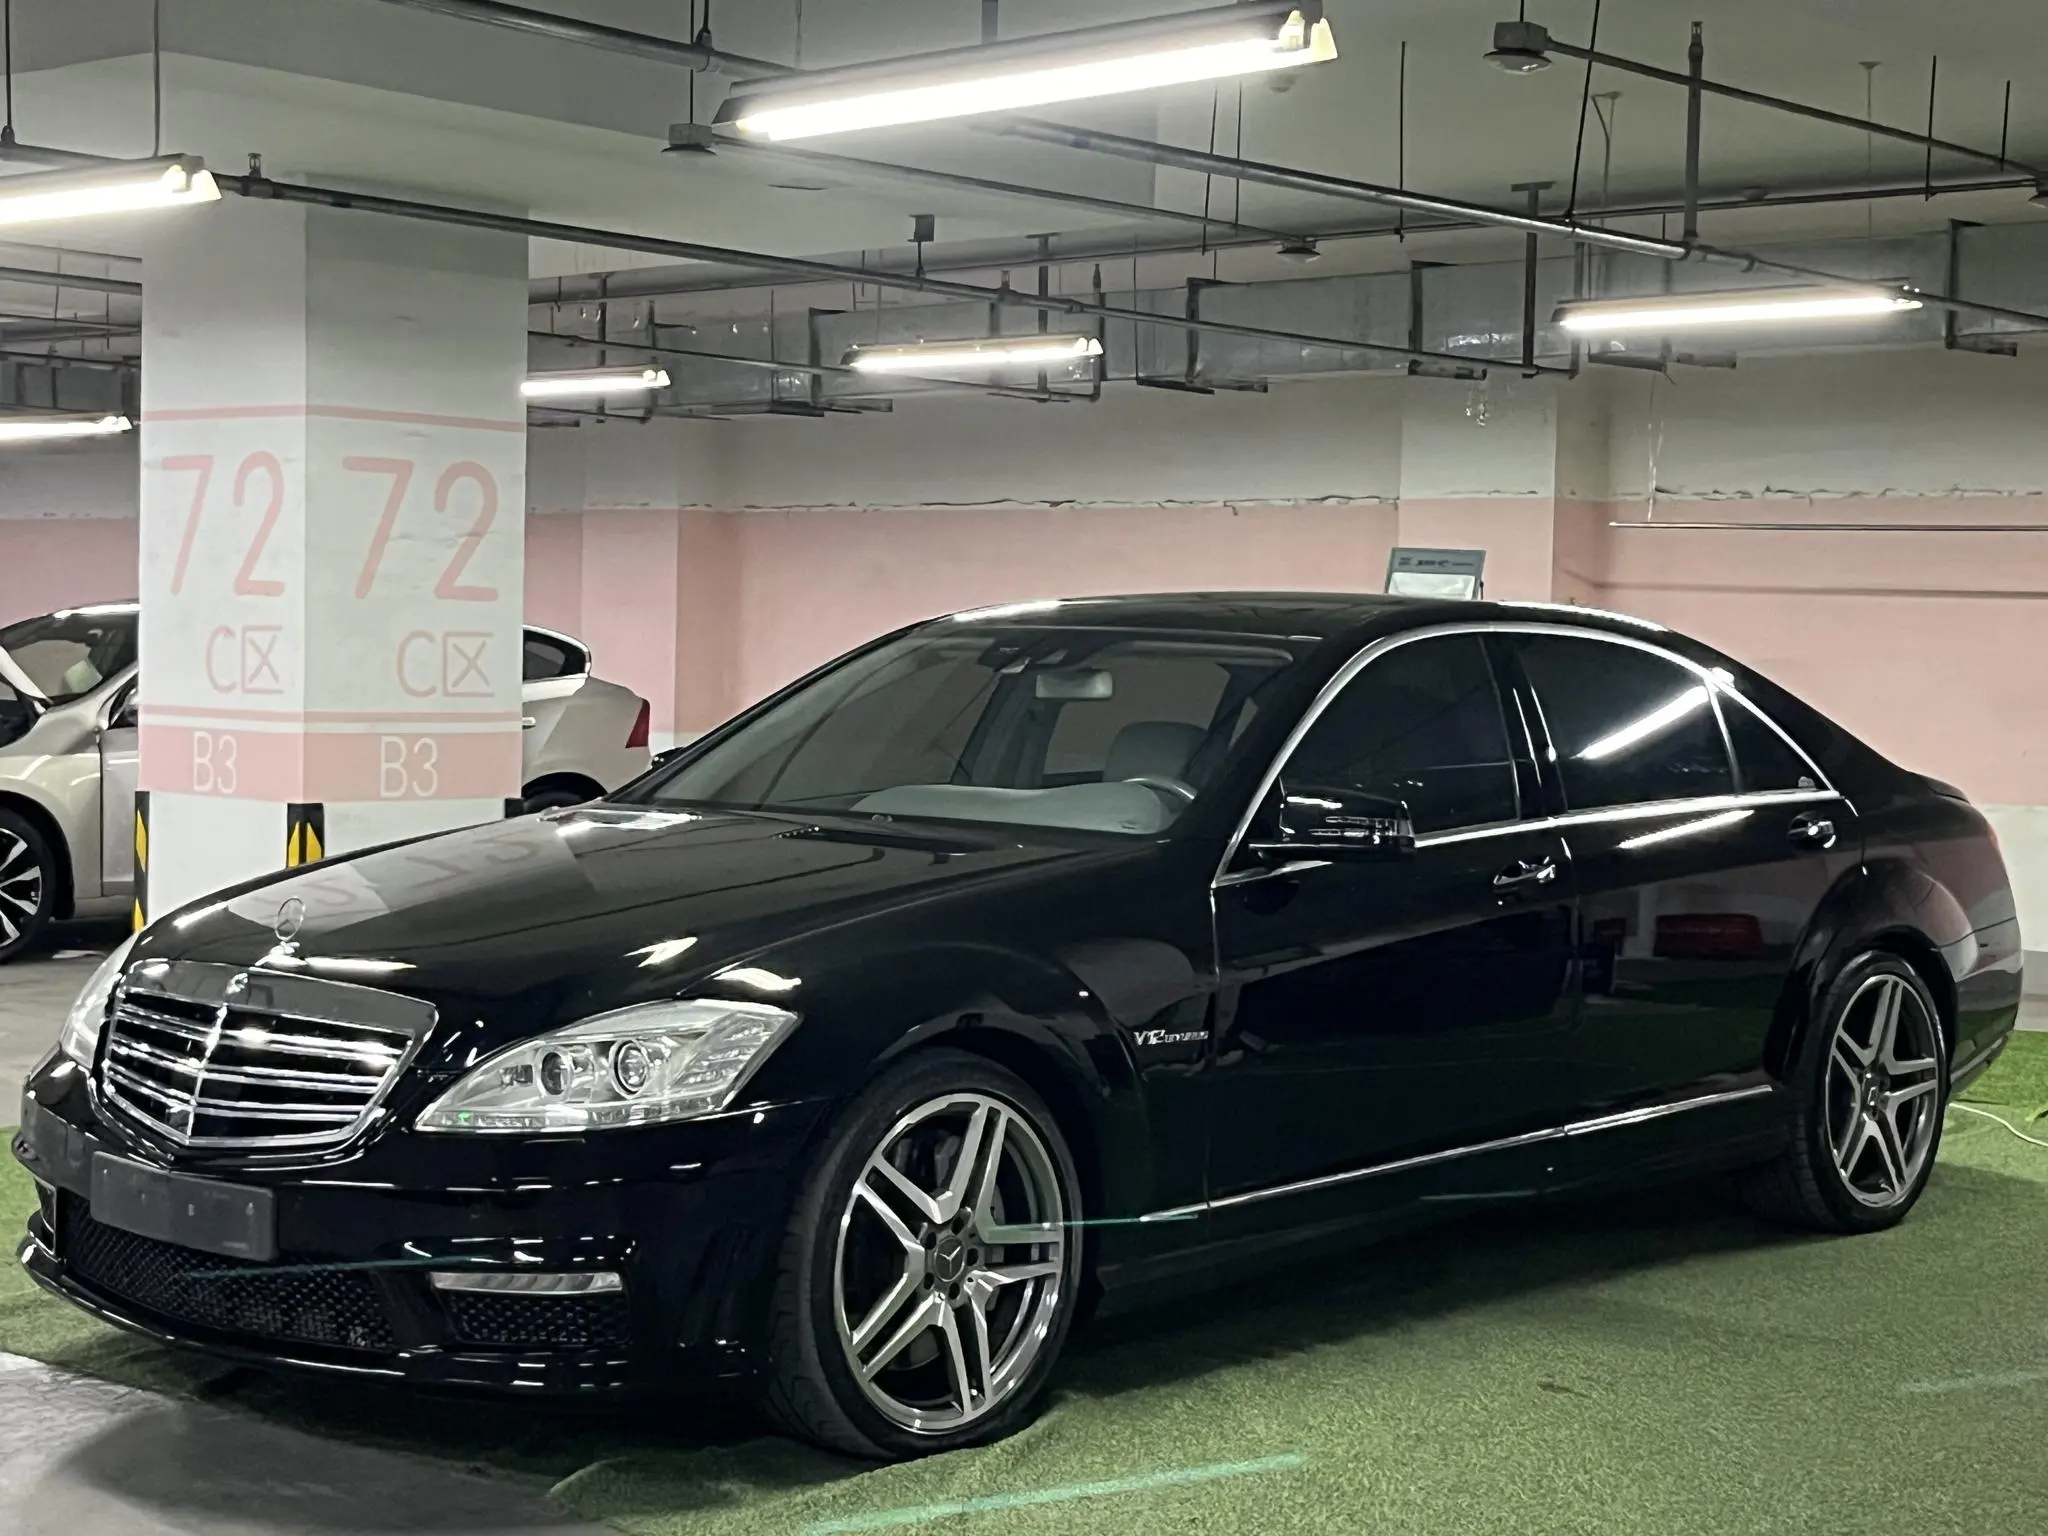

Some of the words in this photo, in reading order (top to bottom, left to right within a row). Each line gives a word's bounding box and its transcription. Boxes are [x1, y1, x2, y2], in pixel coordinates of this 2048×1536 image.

[161, 450, 286, 597] 72
[342, 455, 499, 601] 72
[206, 624, 285, 694] C区
[396, 630, 495, 698] C区
[193, 731, 238, 795] B3
[380, 735, 439, 799] B3
